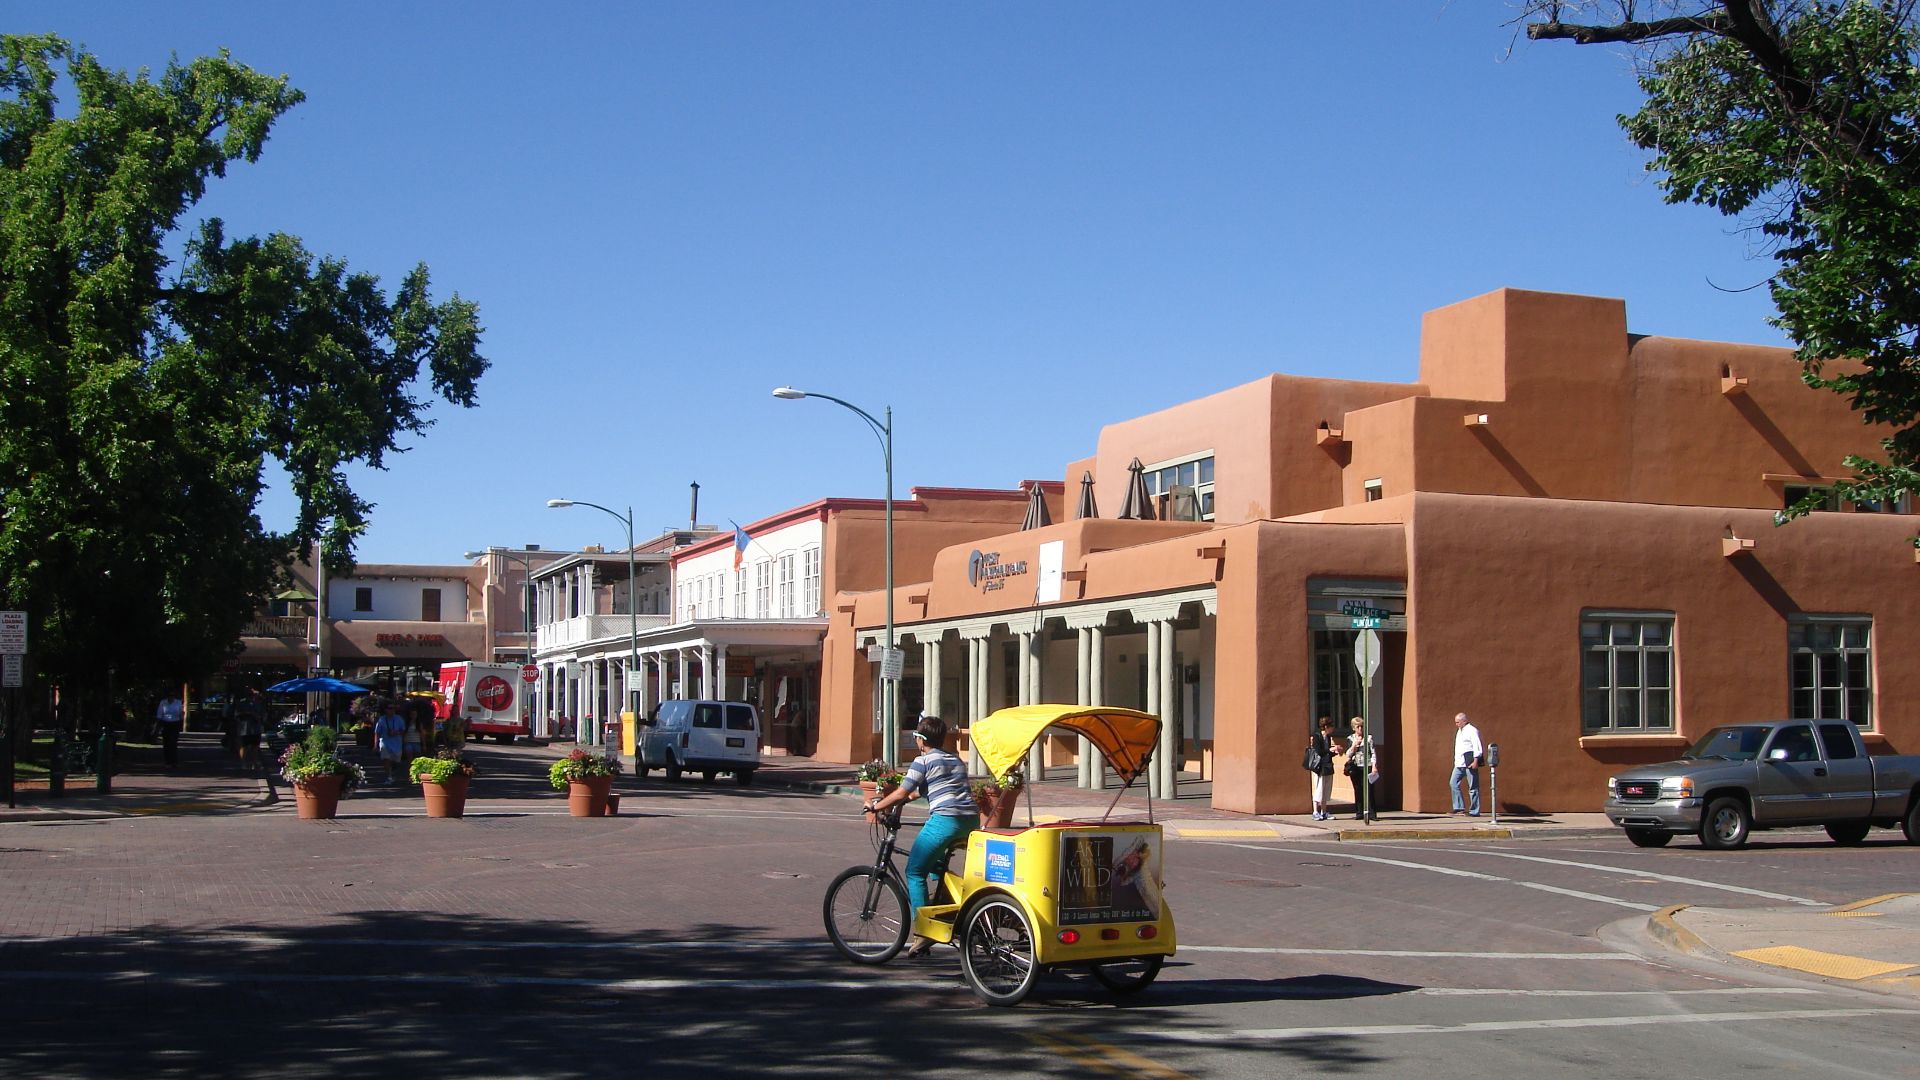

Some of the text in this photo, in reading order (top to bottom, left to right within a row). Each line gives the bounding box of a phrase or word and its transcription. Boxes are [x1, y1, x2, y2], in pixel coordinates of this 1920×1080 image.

[1353, 607, 1379, 617] PALACE
[522, 670, 538, 678] STOP
[1076, 841, 1105, 857] ART
[1066, 868, 1111, 888] WILD
